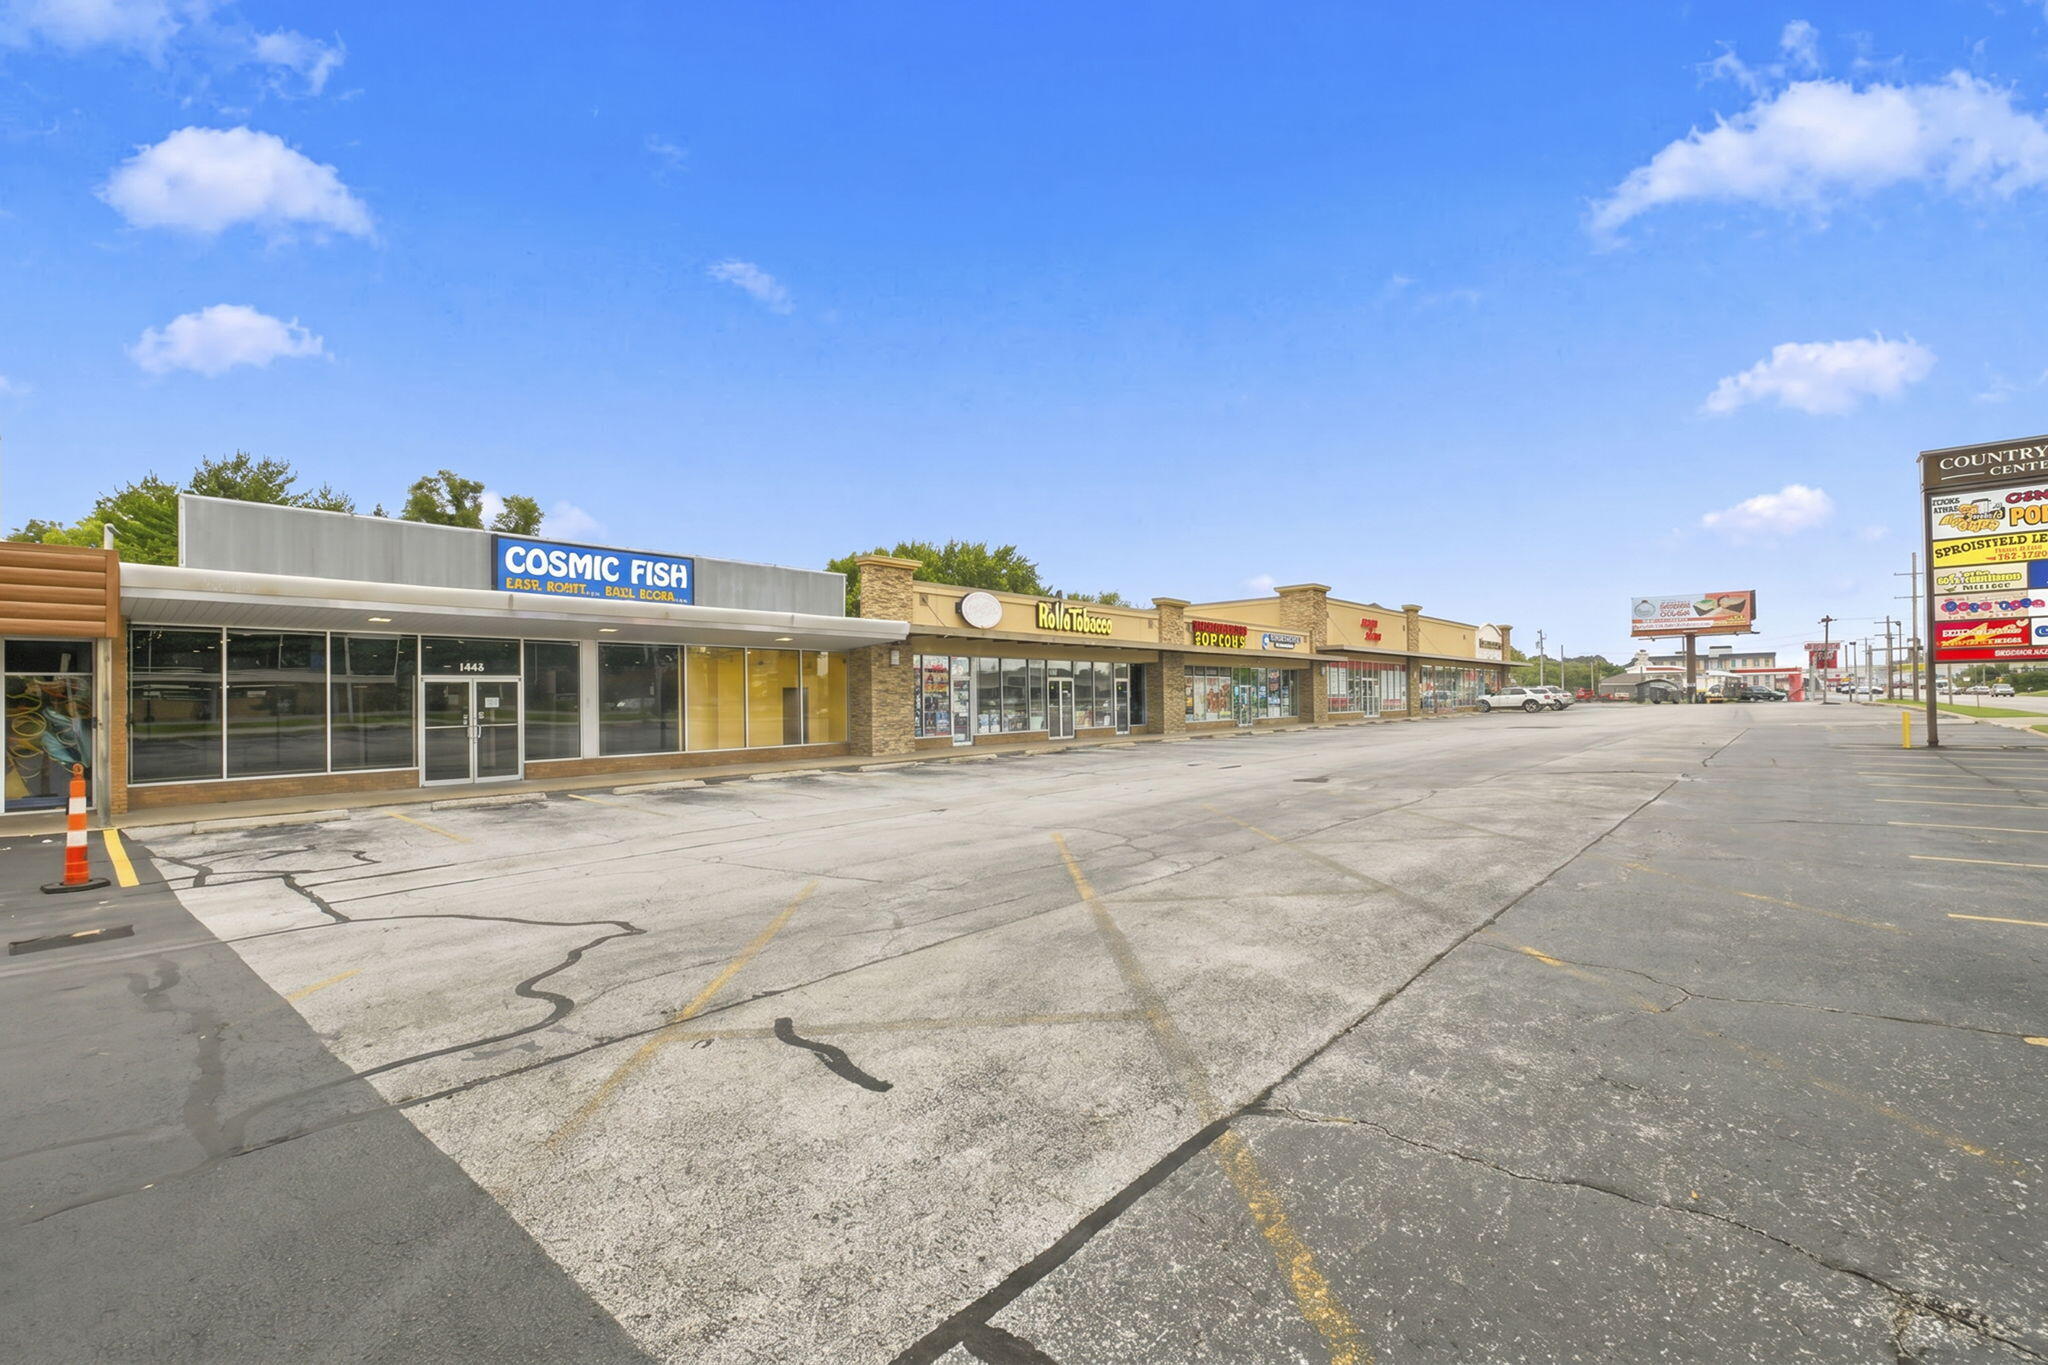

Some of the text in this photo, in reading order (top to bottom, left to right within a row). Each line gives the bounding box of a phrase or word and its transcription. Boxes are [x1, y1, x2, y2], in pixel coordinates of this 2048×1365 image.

[1940, 445, 2048, 470] COUNTRY
[505, 546, 687, 588] COSMIC FISH
[1068, 607, 1113, 634] Tobacco
